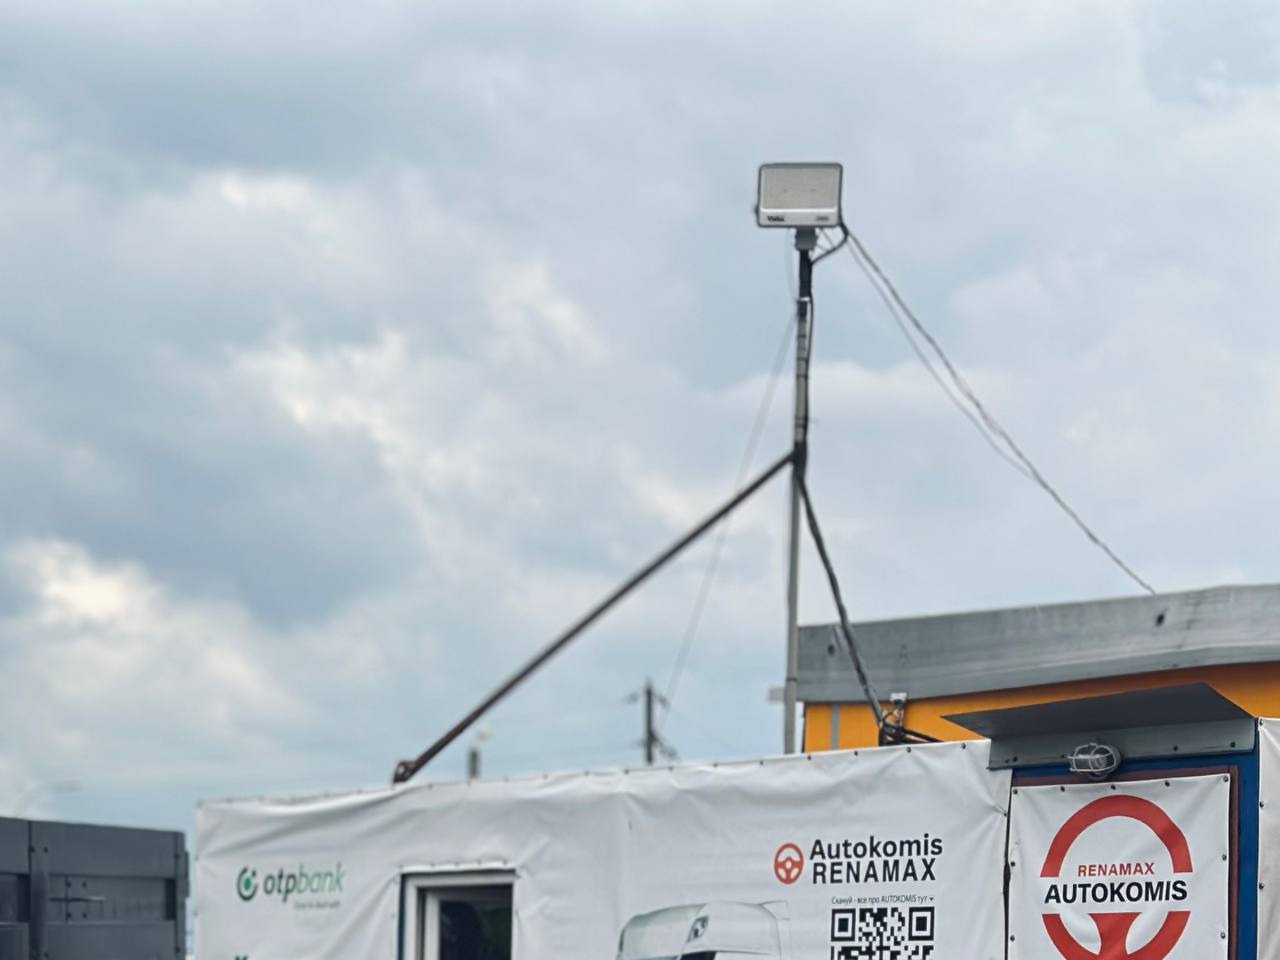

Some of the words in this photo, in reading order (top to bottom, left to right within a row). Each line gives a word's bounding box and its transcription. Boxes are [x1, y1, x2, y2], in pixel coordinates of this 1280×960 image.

[809, 833, 943, 861] Autokomis
[263, 861, 345, 903] otpbank
[812, 858, 936, 884] RENAMAX
[1077, 862, 1155, 877] RENAMAX
[880, 894, 917, 904] AUTOKOMIS
[1044, 880, 1188, 904] AUTOKOMIS
